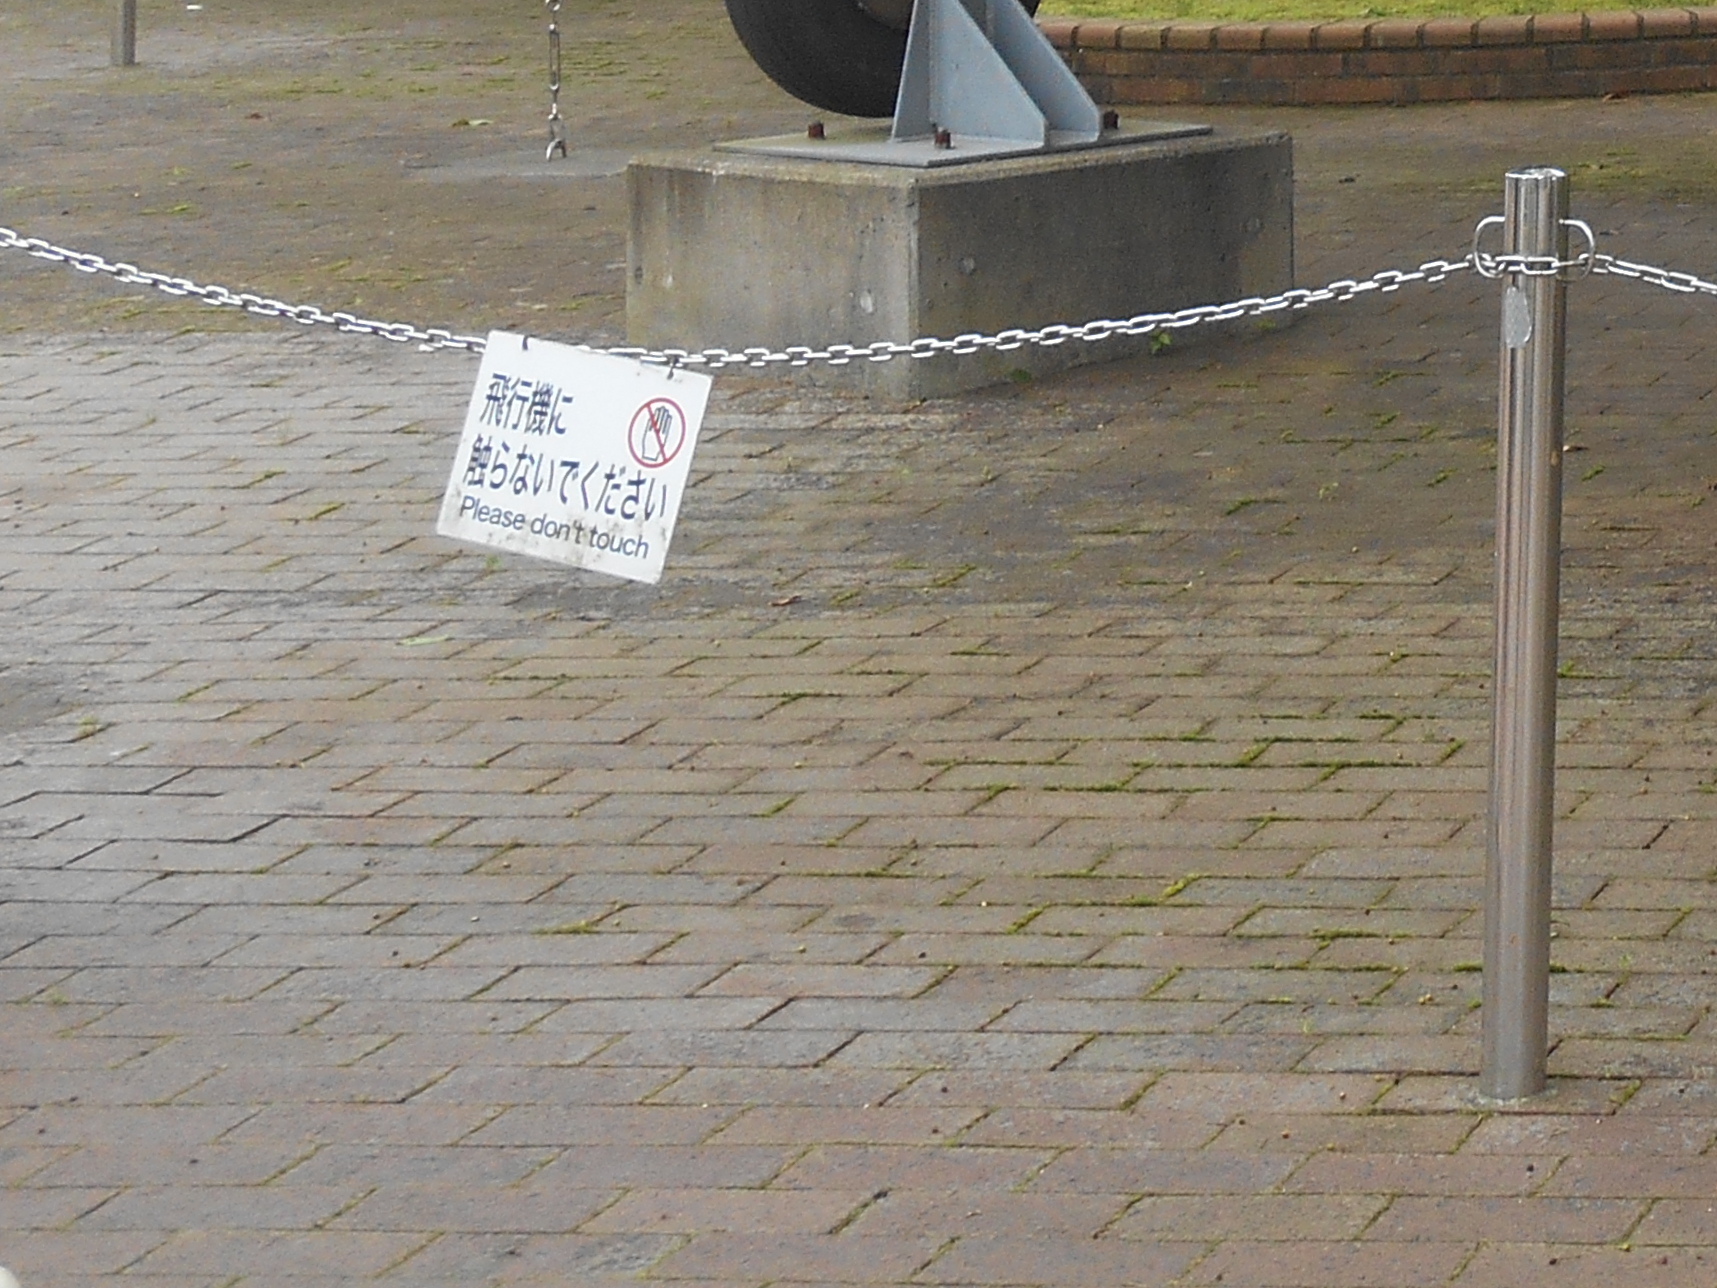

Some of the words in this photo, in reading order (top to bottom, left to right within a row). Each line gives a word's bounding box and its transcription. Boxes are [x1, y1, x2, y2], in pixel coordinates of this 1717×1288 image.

[480, 373, 573, 436] 飛行機に
[463, 434, 667, 521] 触らないでください
[460, 495, 525, 530] Please
[530, 512, 583, 545] don't
[589, 527, 649, 559] touch
